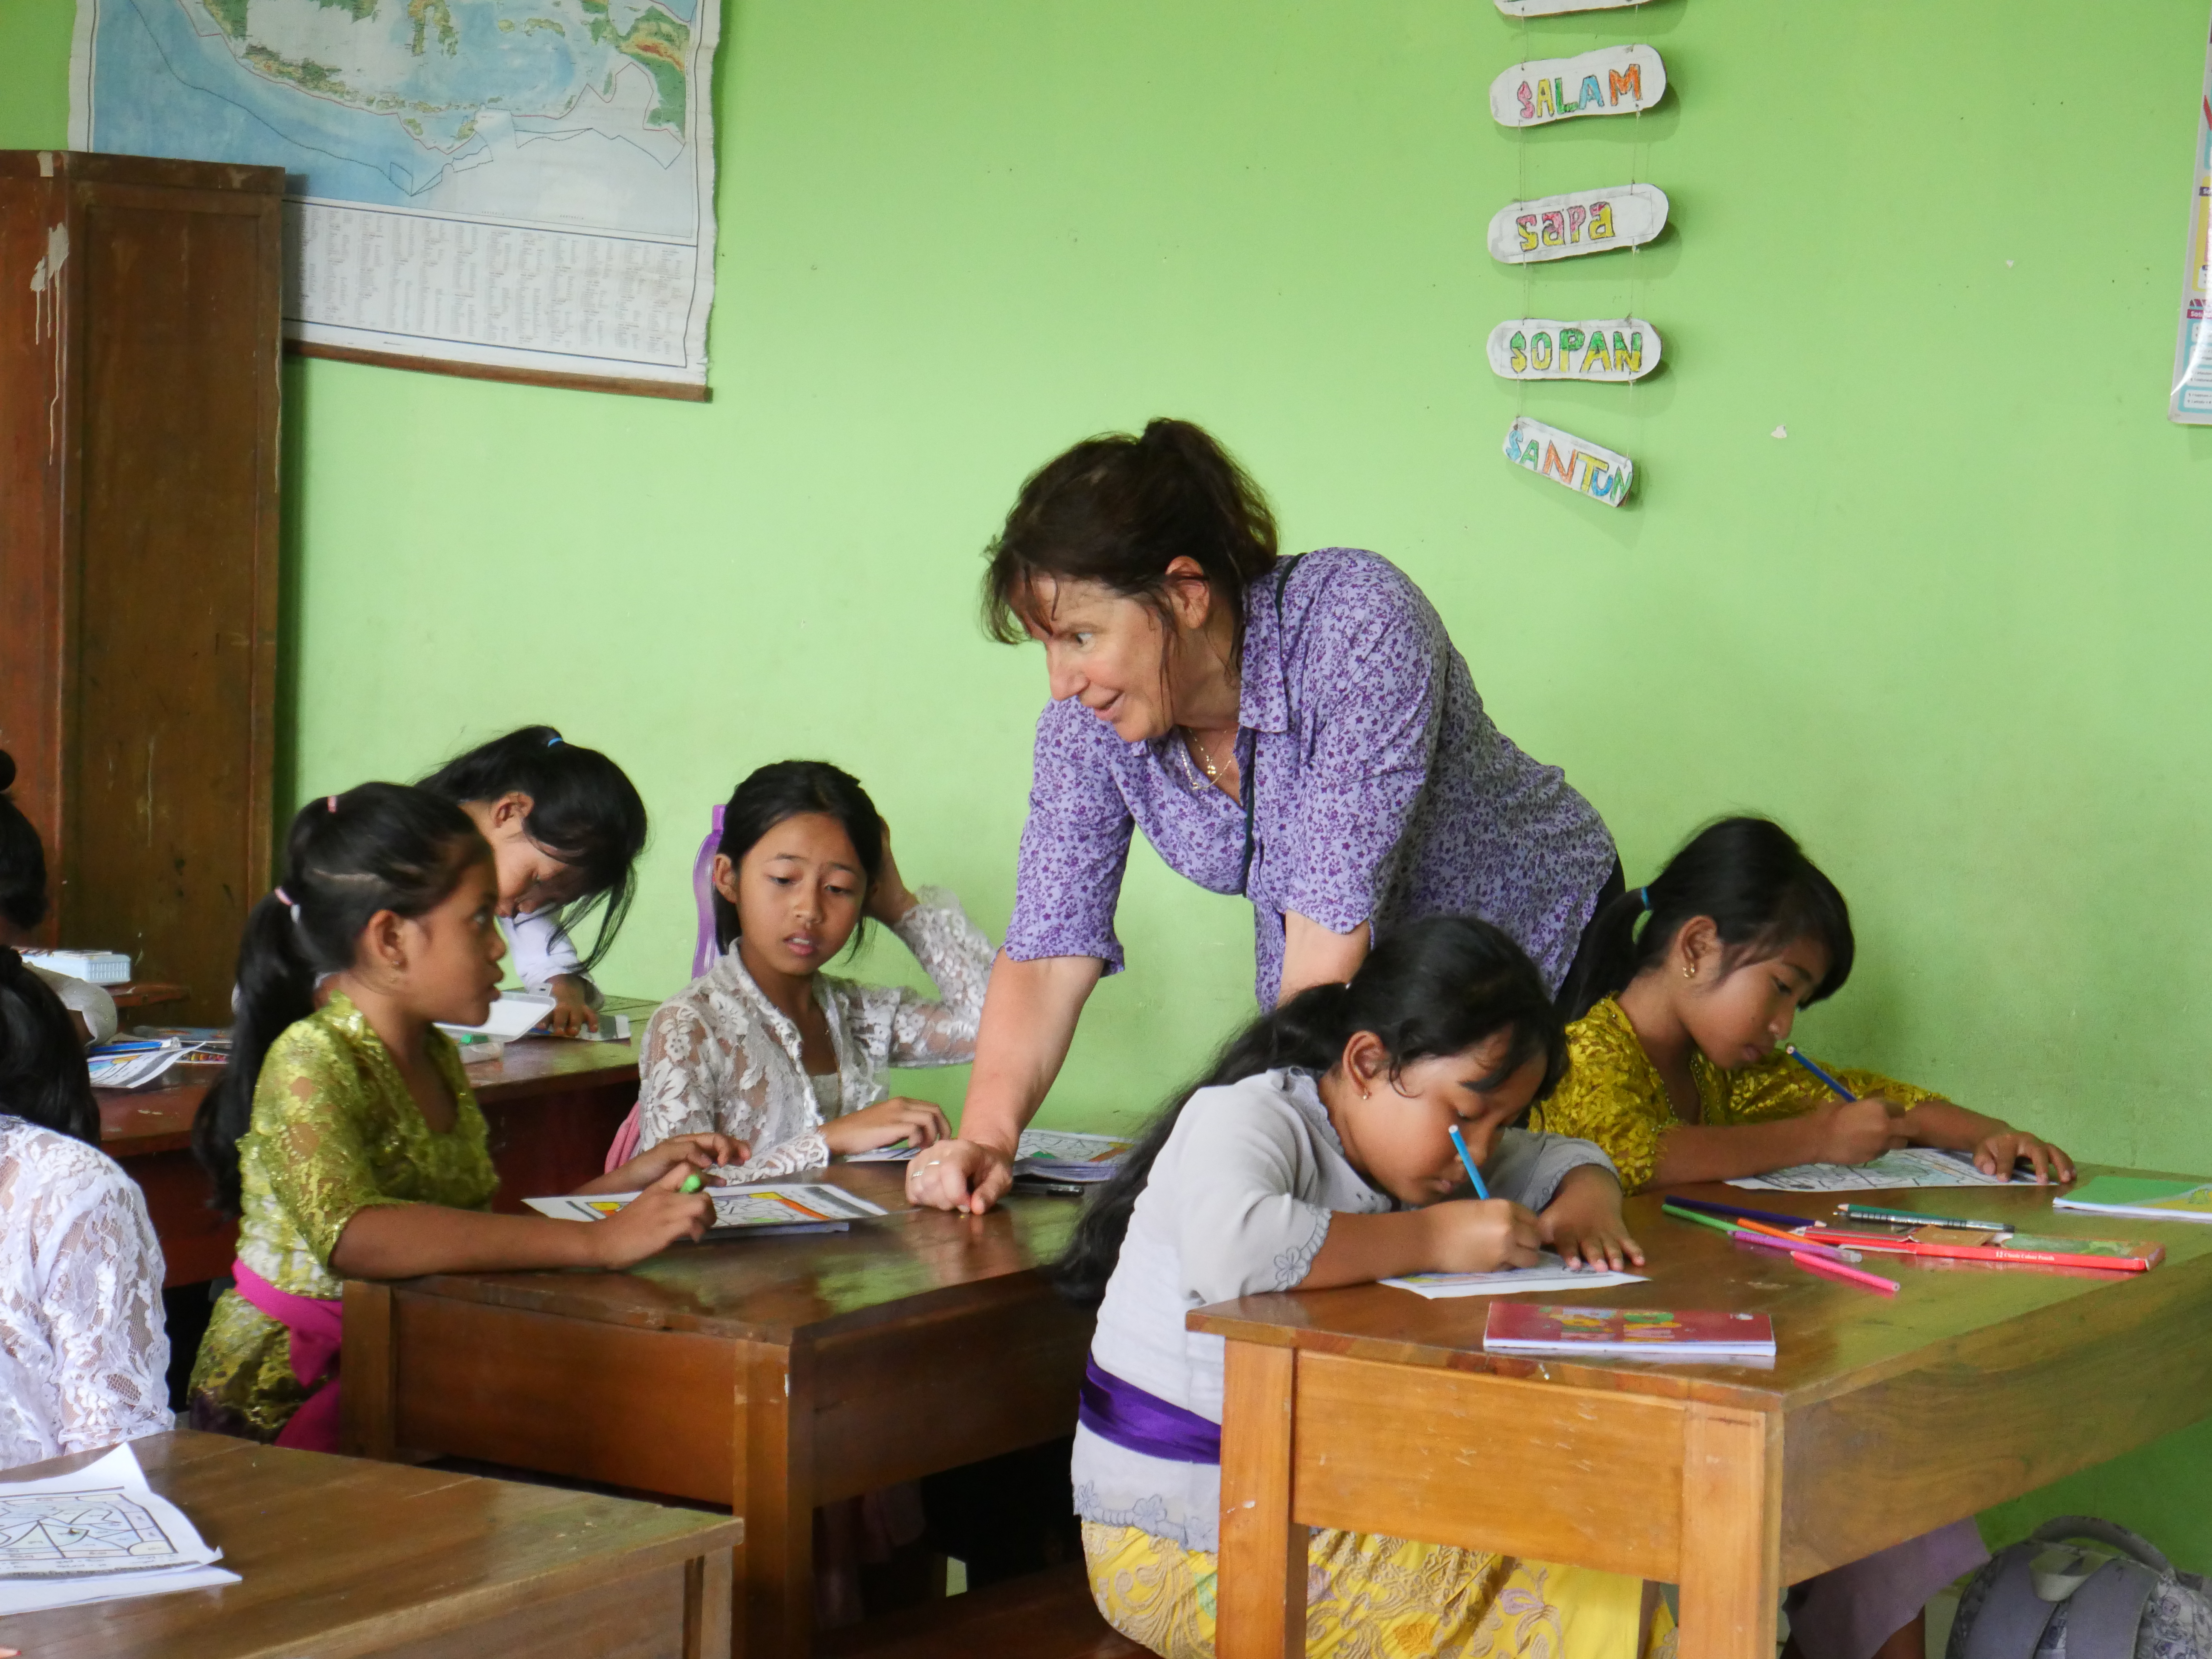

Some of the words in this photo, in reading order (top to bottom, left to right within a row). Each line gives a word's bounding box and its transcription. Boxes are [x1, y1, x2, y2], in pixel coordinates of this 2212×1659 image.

[1517, 63, 1642, 119] SALAM
[1510, 328, 1643, 373] SOPAN
[1505, 429, 1632, 501] SANTUN
